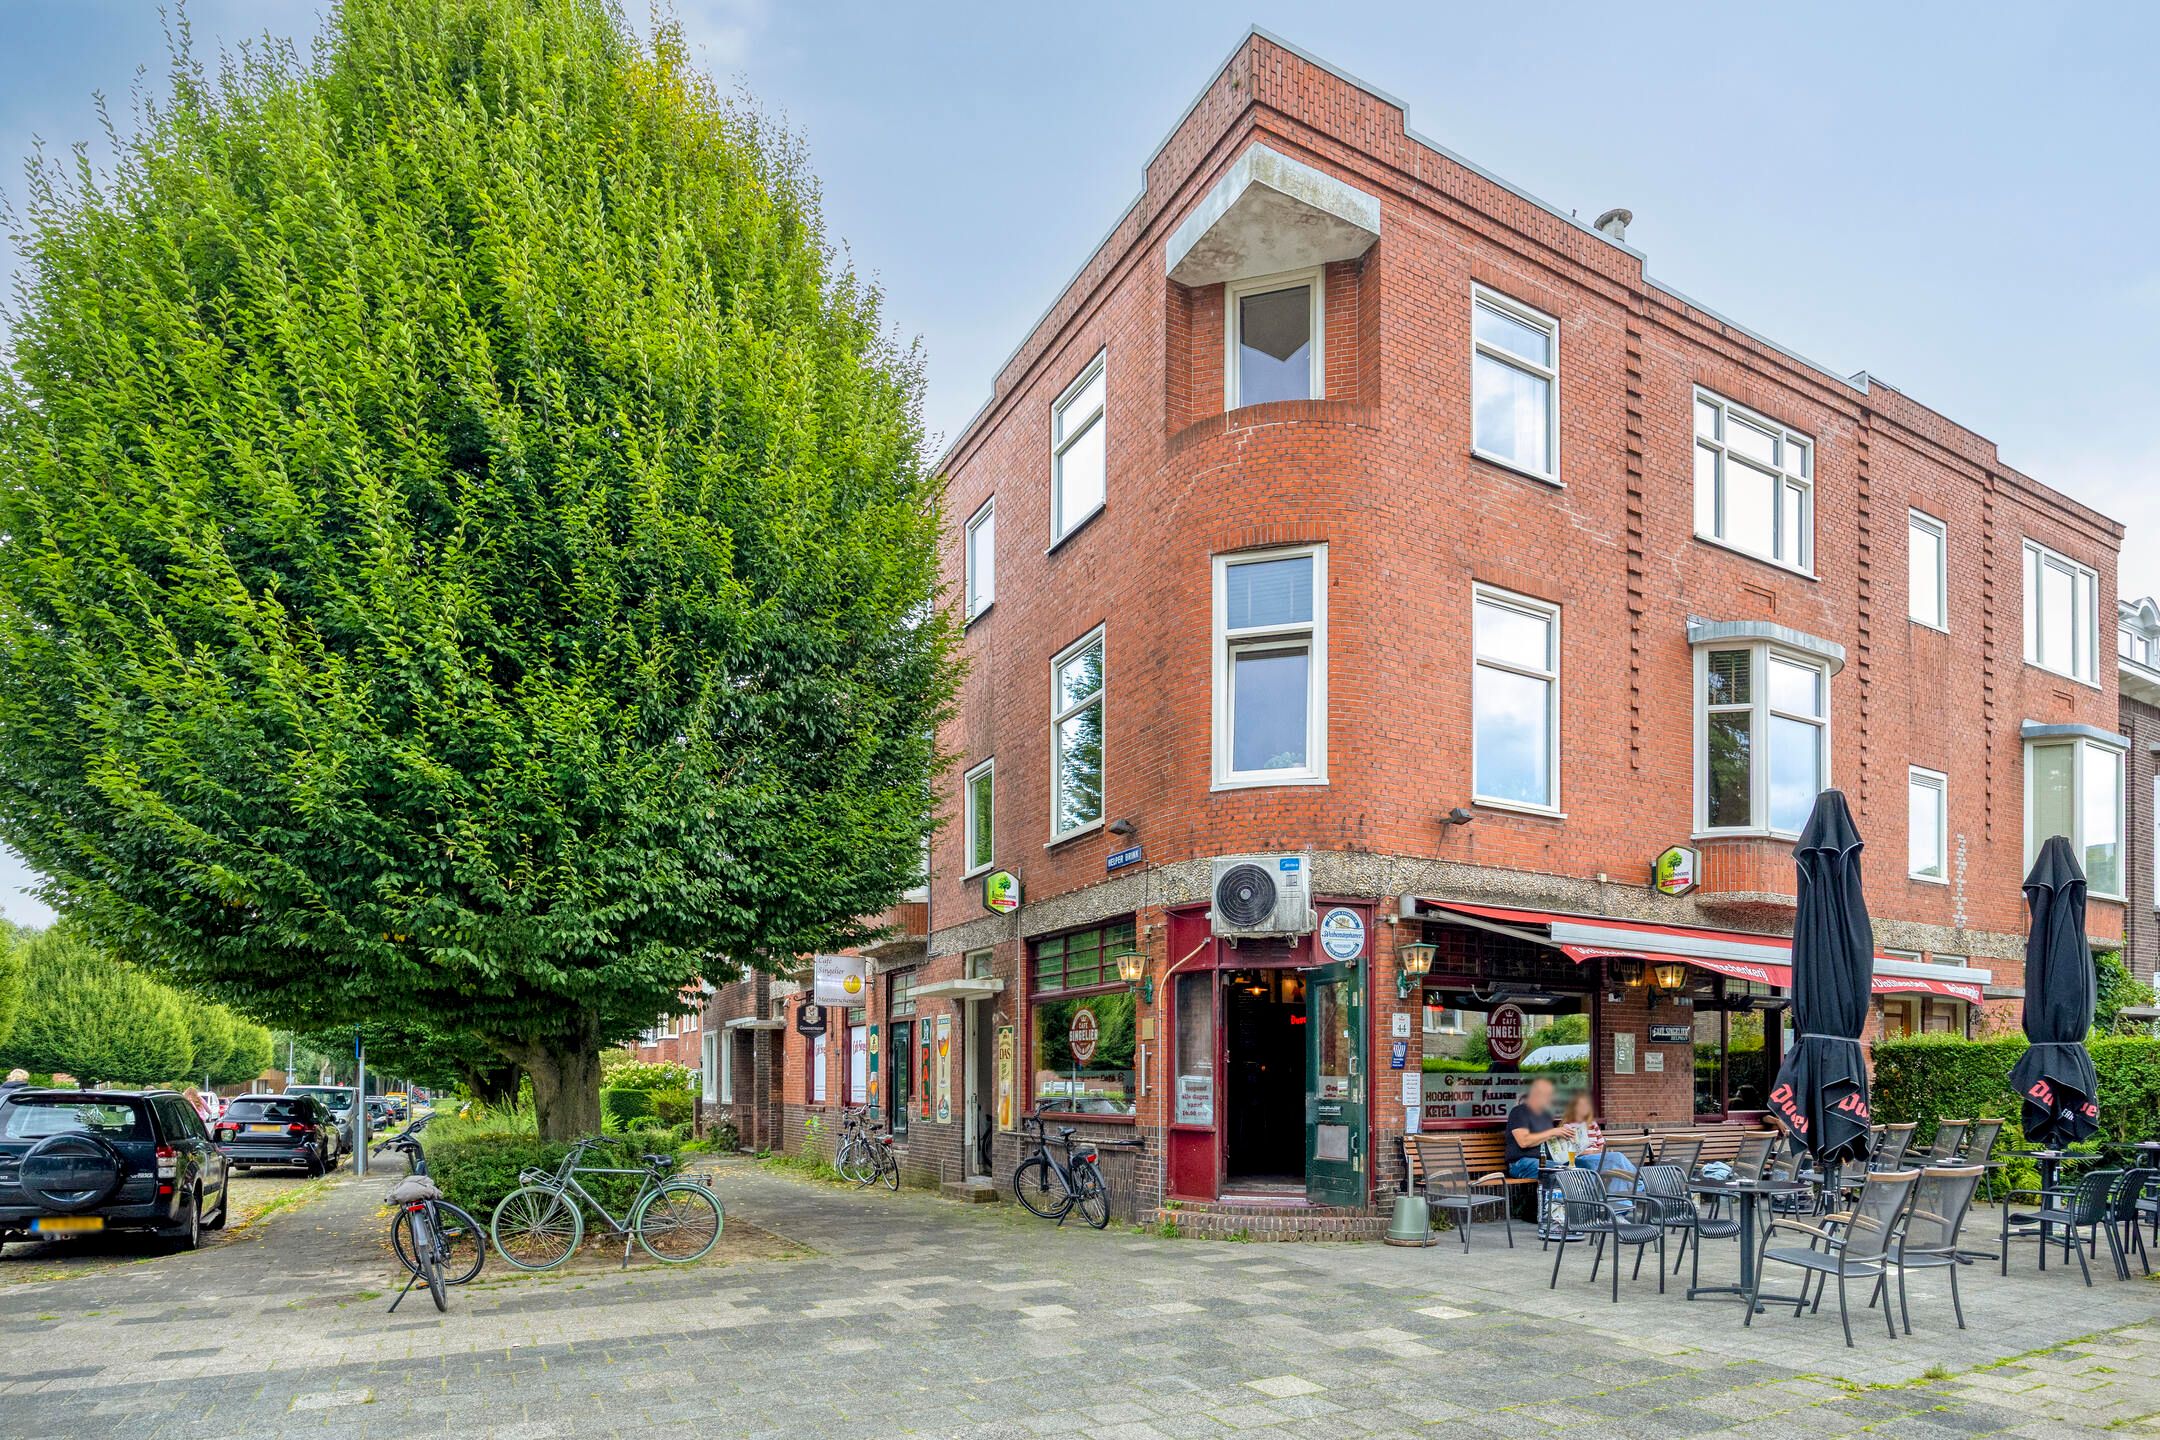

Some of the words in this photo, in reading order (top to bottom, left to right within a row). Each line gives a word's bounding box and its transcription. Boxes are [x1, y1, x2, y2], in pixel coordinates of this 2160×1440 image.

[818, 966, 845, 976] Singelier
[1613, 958, 1641, 974] Duvel
[1069, 1028, 1099, 1041] SINGELIER
[1397, 1023, 1407, 1033] 44
[999, 1047, 1011, 1060] DAS
[921, 1047, 930, 1116] PALM
[1457, 1076, 1493, 1086] Erkend
[1425, 1091, 1475, 1102] HOOGHOUDT
[1471, 1103, 1507, 1117] BOLS
[1770, 1083, 1809, 1134] Duvel
